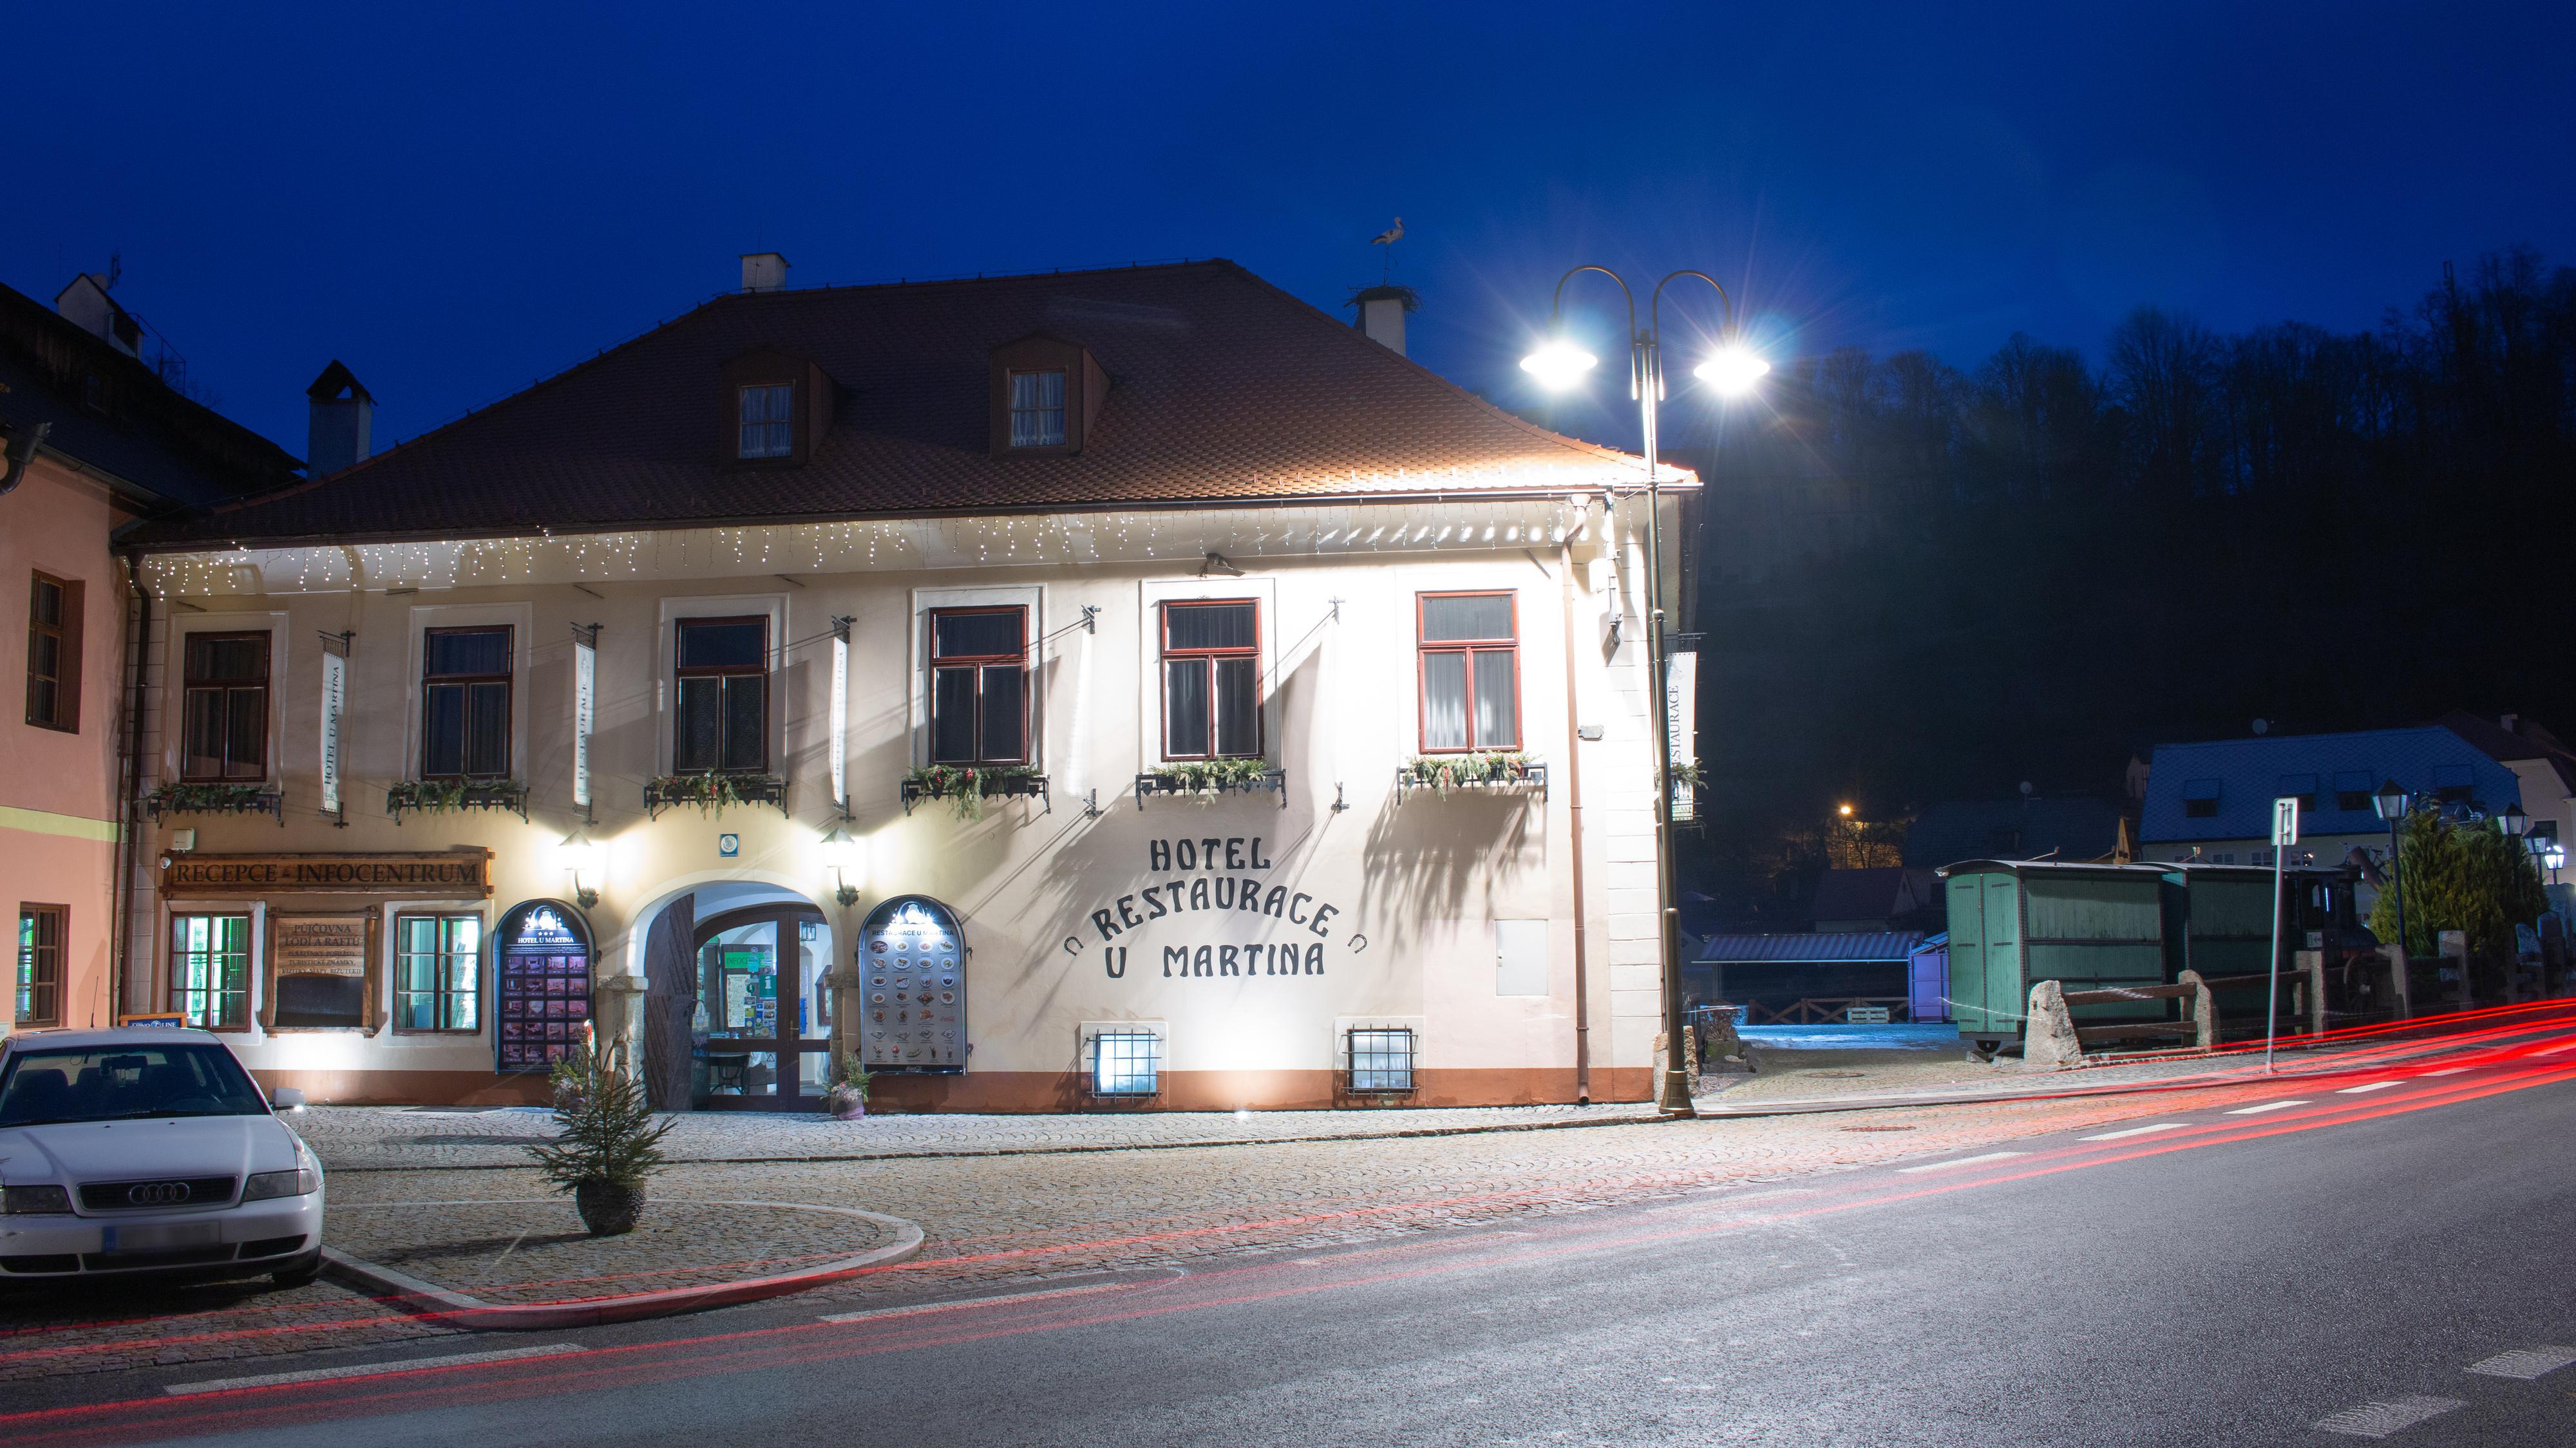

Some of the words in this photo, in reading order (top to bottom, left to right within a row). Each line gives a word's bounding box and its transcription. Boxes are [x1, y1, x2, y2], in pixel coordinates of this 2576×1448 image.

[330, 666, 340, 724] MARTINA
[329, 728, 336, 738] U
[1668, 685, 1681, 766] ESTAURACE
[323, 742, 336, 785] HOTEL
[1150, 836, 1271, 872] HOTEL
[175, 864, 277, 883] RECEPCE
[296, 863, 478, 883] INFOCENTRUM
[1091, 876, 1340, 941] RESTAURACE
[314, 937, 322, 946] A
[1104, 946, 1127, 979] U
[1162, 943, 1325, 977] MARTINA
